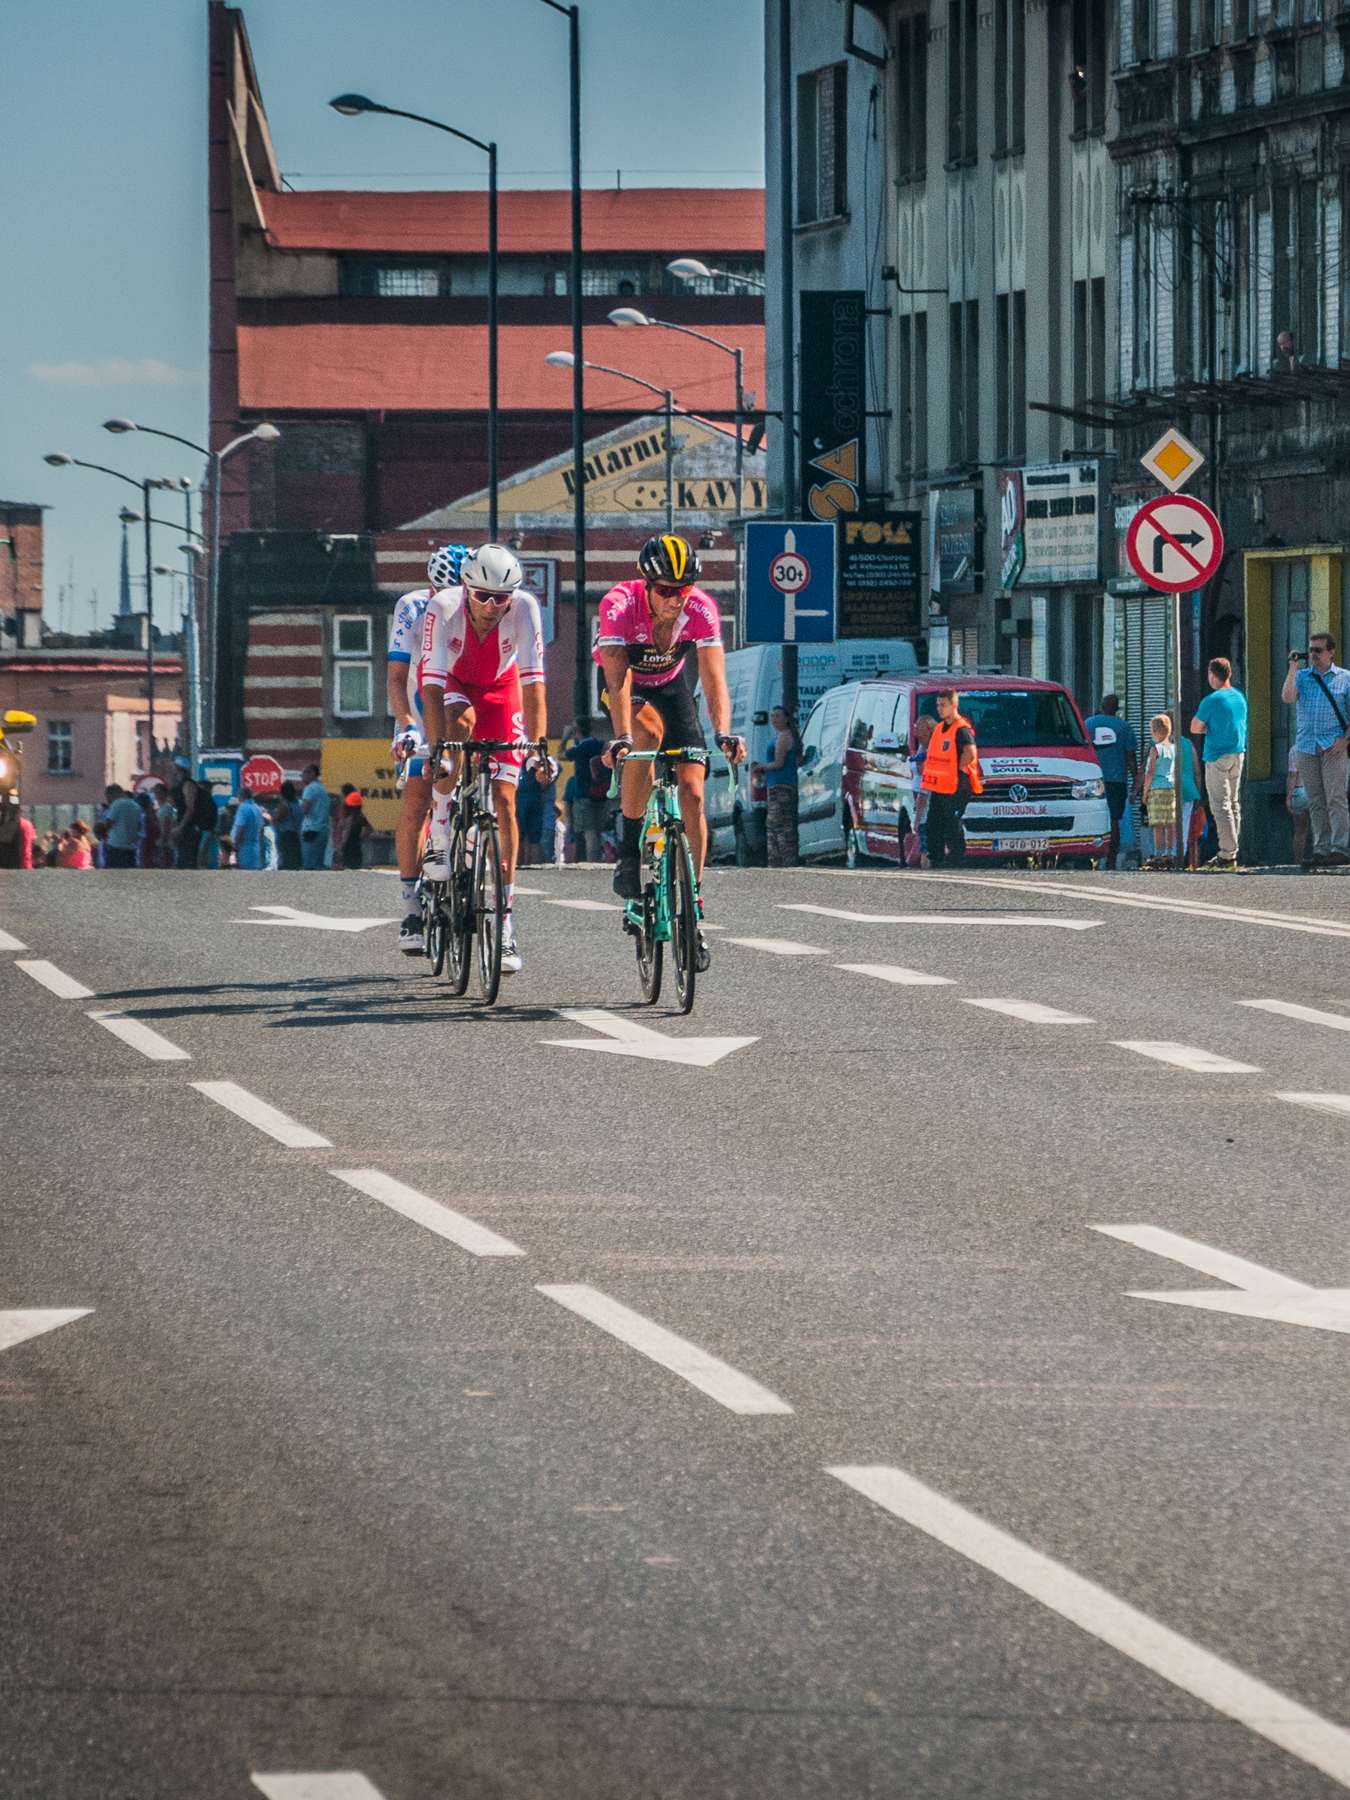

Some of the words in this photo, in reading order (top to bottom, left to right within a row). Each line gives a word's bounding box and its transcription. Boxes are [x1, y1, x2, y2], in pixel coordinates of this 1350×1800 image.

[775, 565, 803, 582] 30t
[424, 613, 436, 651] ORLEN
[245, 773, 277, 786] STOP
